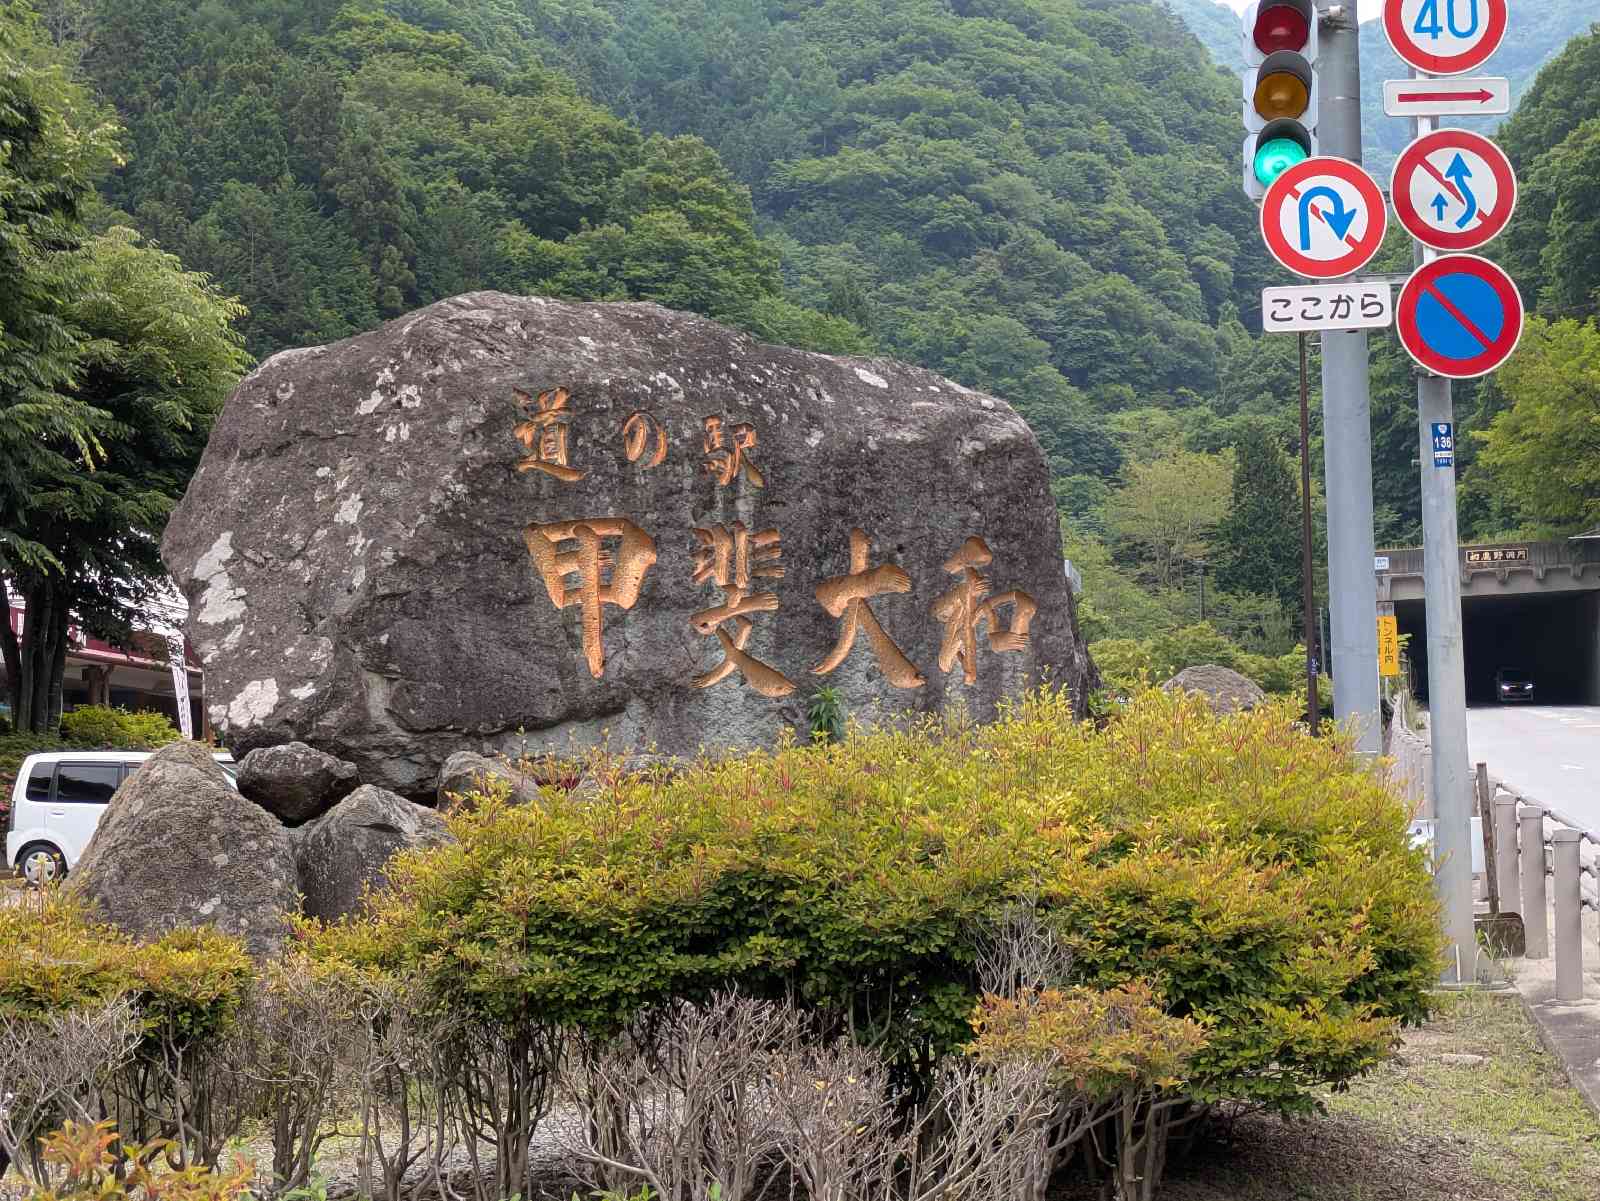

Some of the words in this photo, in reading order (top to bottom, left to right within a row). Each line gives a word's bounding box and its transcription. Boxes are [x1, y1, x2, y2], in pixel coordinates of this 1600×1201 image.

[1414, 0, 1478, 39] 40
[1270, 294, 1384, 322] ここから
[512, 386, 765, 488] 道の駅
[522, 517, 1039, 698] 甲斐大和
[1383, 617, 1394, 665] トンネル内
